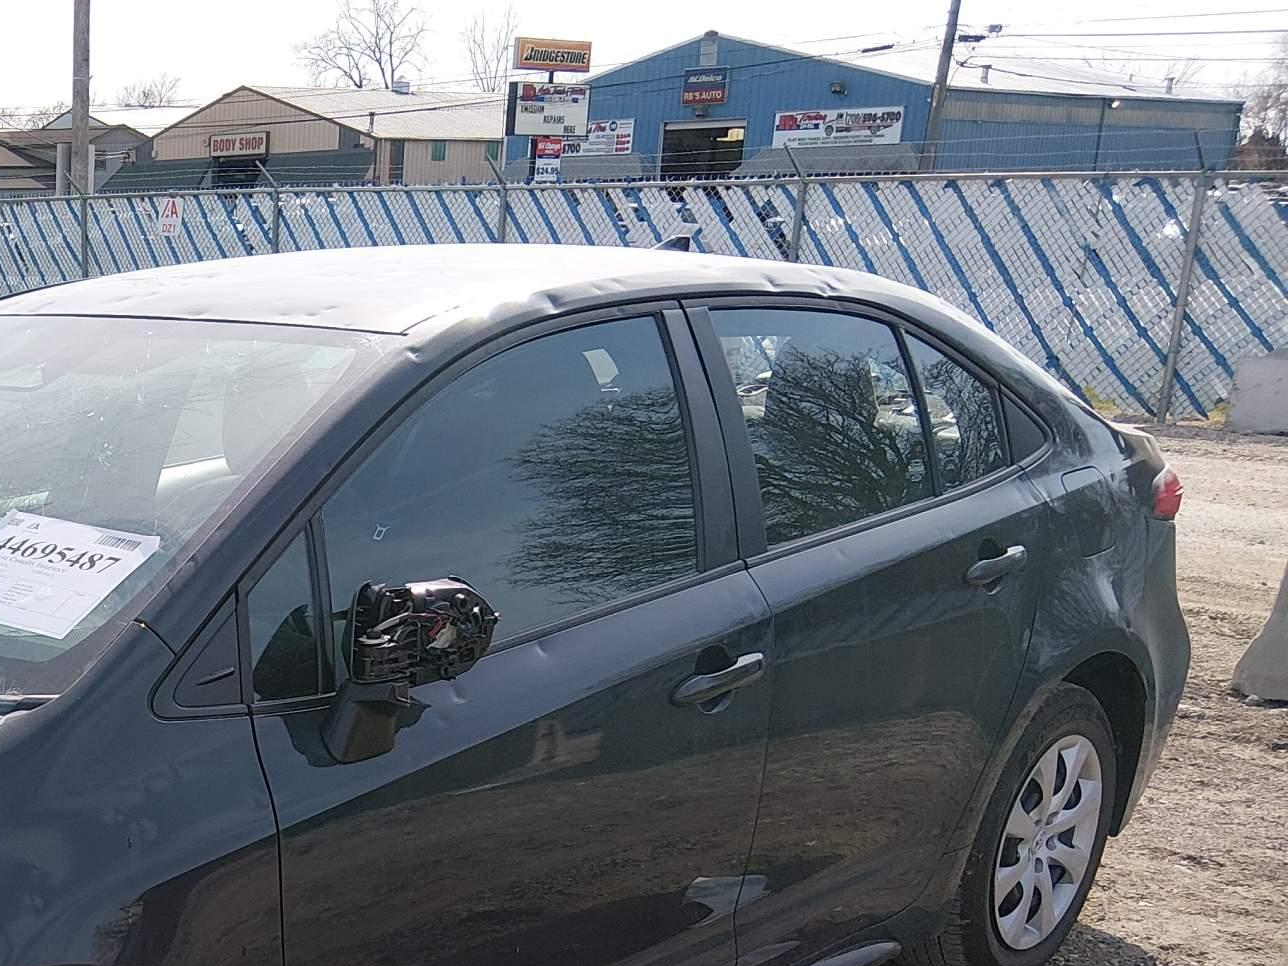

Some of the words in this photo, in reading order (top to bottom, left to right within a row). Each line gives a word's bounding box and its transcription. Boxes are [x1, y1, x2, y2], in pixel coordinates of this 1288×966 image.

[524, 46, 588, 64] BRIDGESTONE
[701, 90, 722, 99] AUTO
[521, 105, 544, 113] EMISSION
[544, 116, 565, 124] REPAIRS
[563, 126, 576, 134] HERE
[213, 139, 236, 152] BODY
[239, 138, 263, 150] SHOP
